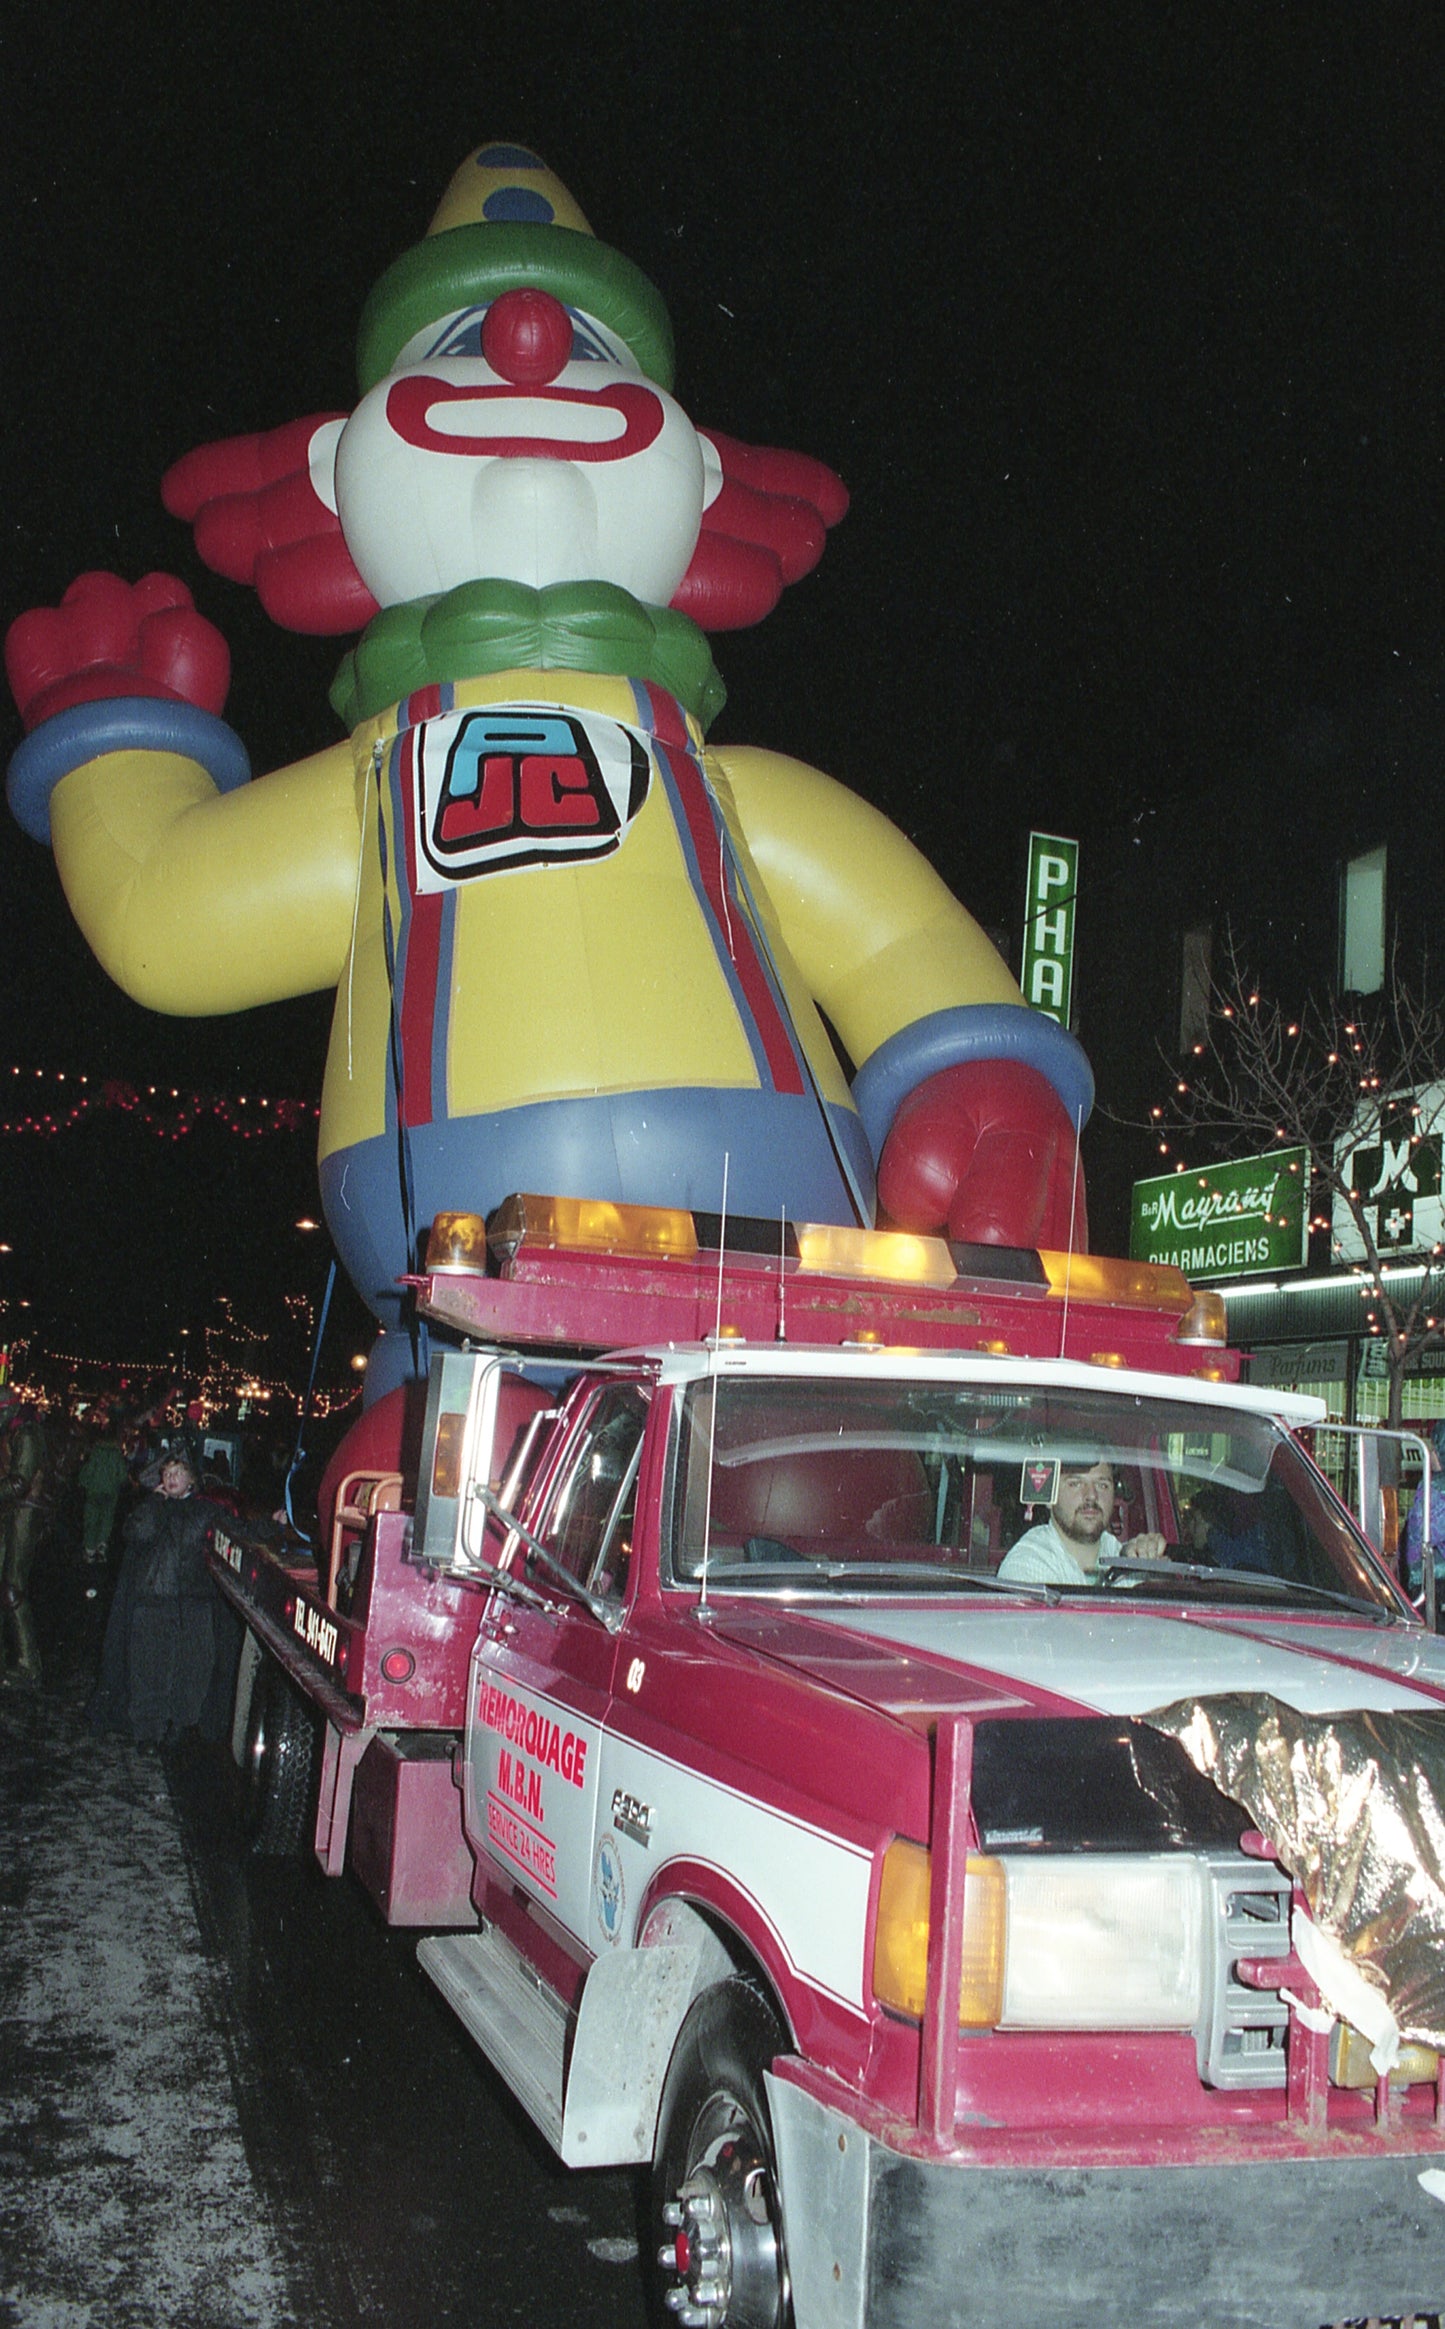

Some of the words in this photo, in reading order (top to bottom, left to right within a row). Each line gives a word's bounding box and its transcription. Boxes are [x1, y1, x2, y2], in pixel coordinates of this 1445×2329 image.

[1031, 854, 1069, 1023] PHA
[1269, 1353, 1336, 1382] Parfums
[478, 1681, 587, 1789] REMORQUAGE
[498, 1748, 544, 1823] M.B.N.
[487, 1802, 518, 1851] SERVICE
[520, 1830, 531, 1861] 24
[532, 1840, 556, 1884] HRES
